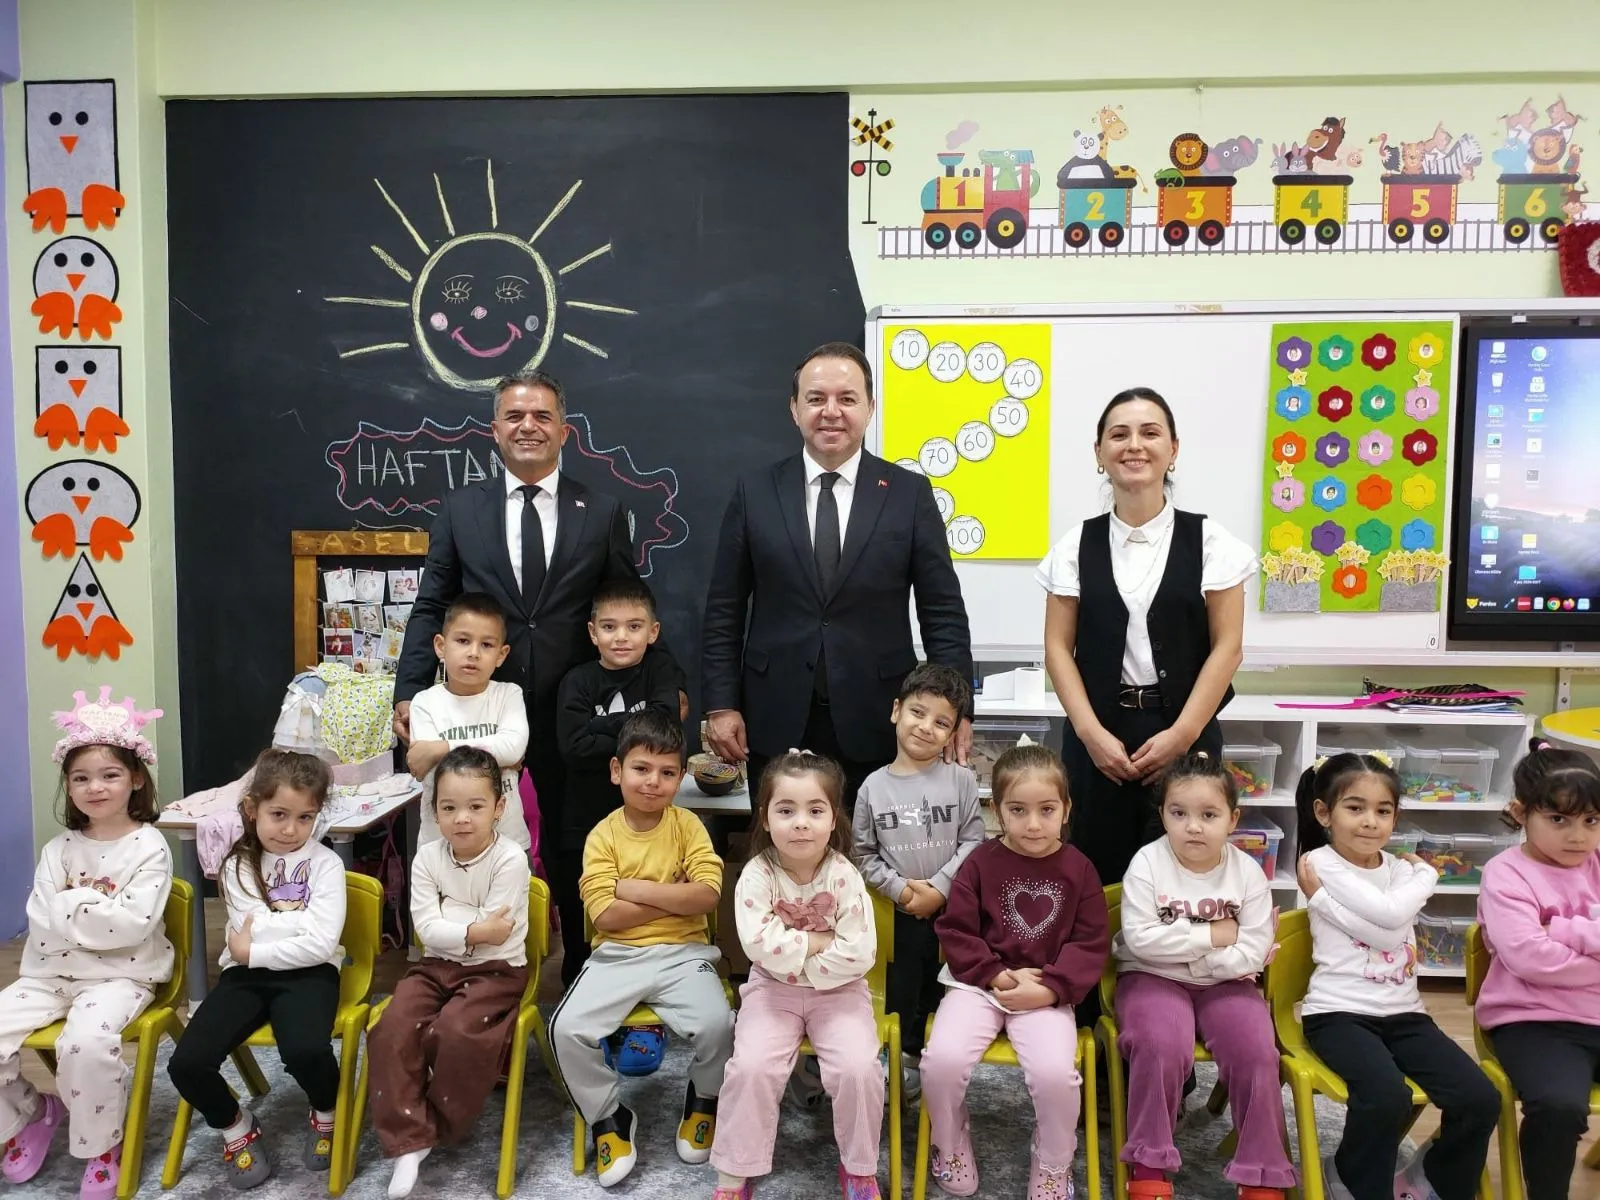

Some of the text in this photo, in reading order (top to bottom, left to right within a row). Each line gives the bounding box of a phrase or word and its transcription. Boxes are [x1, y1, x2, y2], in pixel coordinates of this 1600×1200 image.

[953, 180, 966, 207] 1
[1300, 189, 1322, 218] 4
[1410, 188, 1431, 218] 5
[1524, 188, 1546, 217] 6
[1086, 191, 1105, 220] 2
[1184, 190, 1206, 220] 3
[899, 340, 920, 358] 10
[936, 353, 960, 371] 20
[973, 353, 999, 371] 30
[1010, 369, 1036, 388] 40
[996, 406, 1021, 425] 50
[963, 431, 988, 451] 60
[926, 447, 949, 467] 70
[935, 496, 947, 514] 0
[321, 532, 424, 554] ASEL
[947, 527, 983, 545] 100
